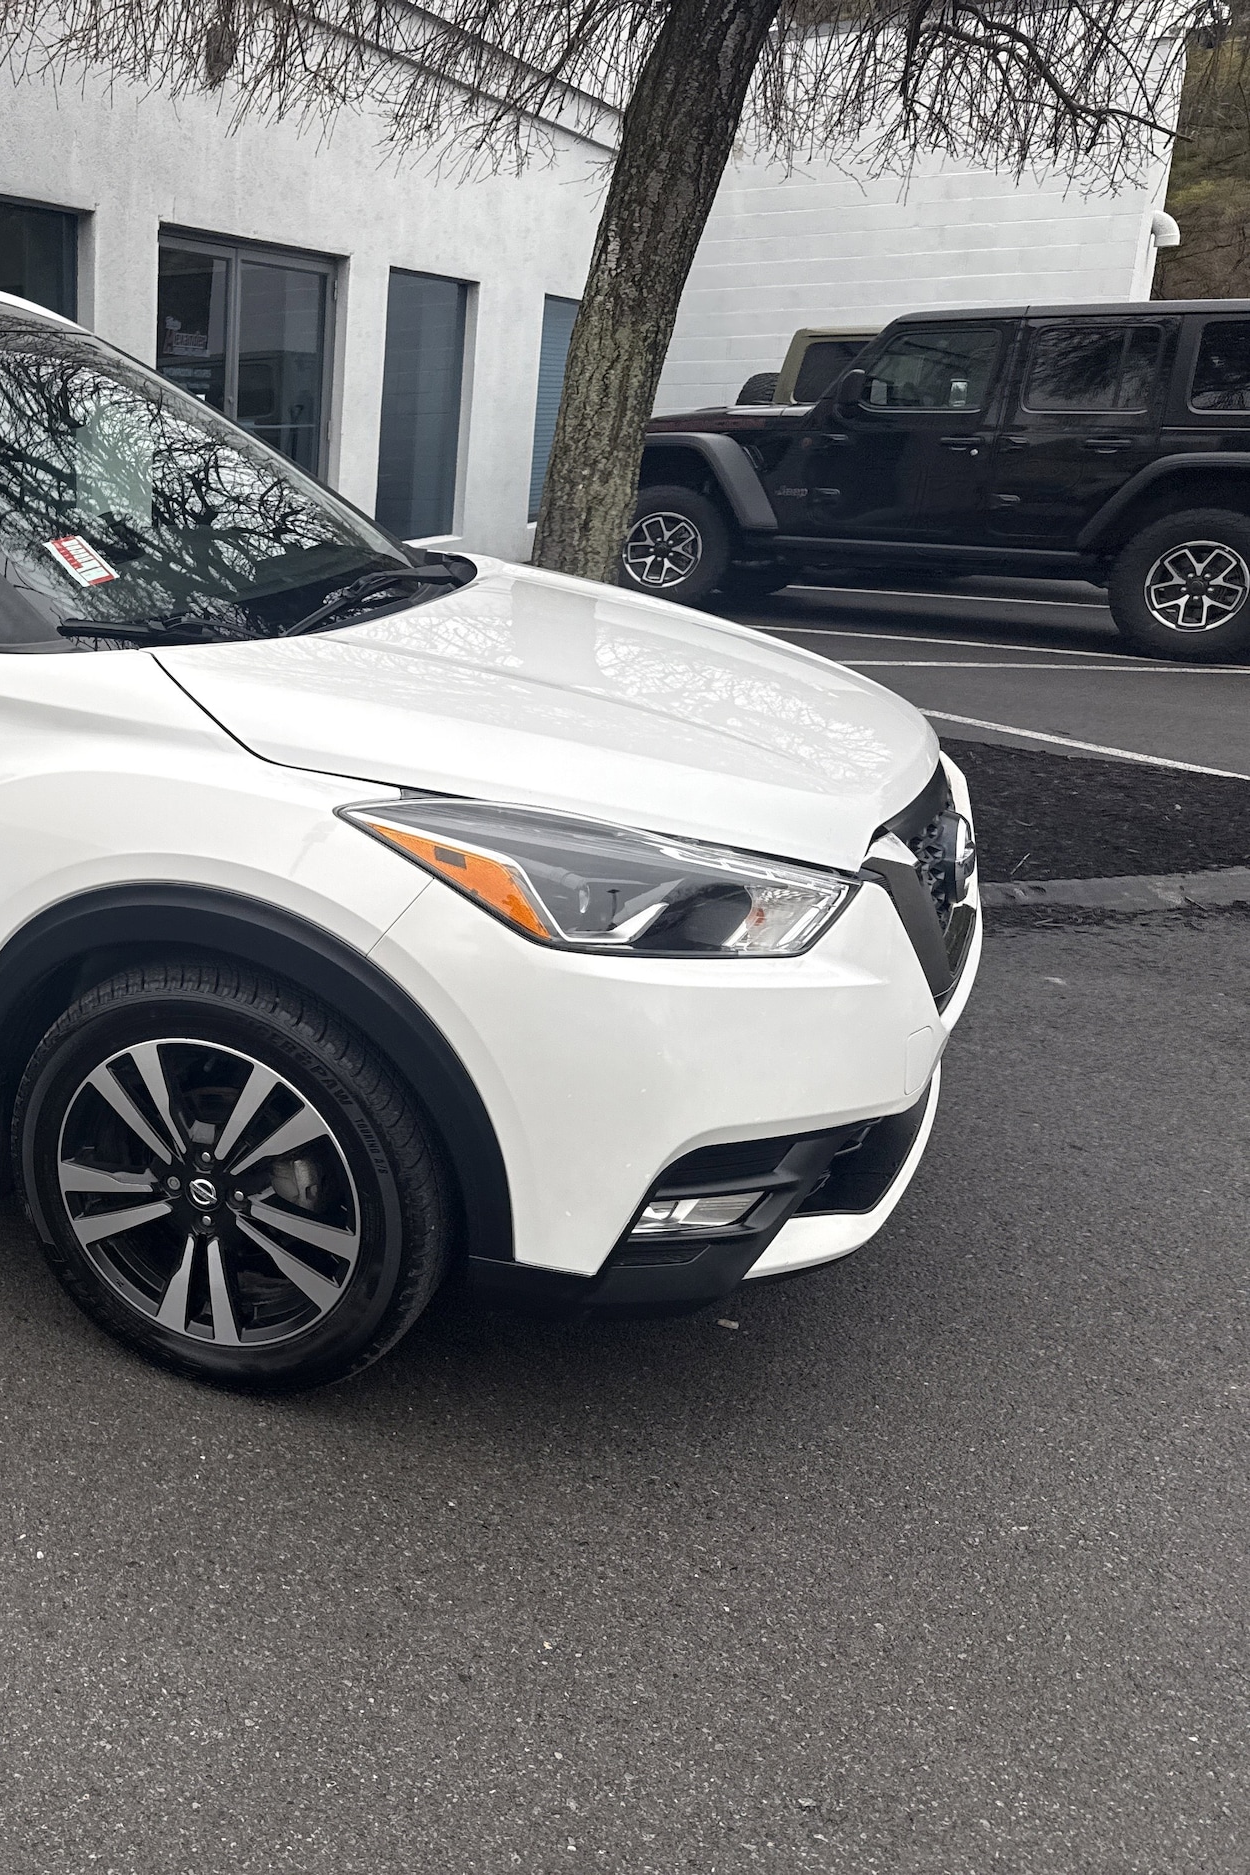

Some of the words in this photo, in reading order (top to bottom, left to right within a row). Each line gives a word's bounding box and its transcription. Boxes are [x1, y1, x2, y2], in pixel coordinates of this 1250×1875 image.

[776, 486, 809, 498] Jeep
[311, 1065, 353, 1106] PAW
[355, 1117, 381, 1155] TOURING
